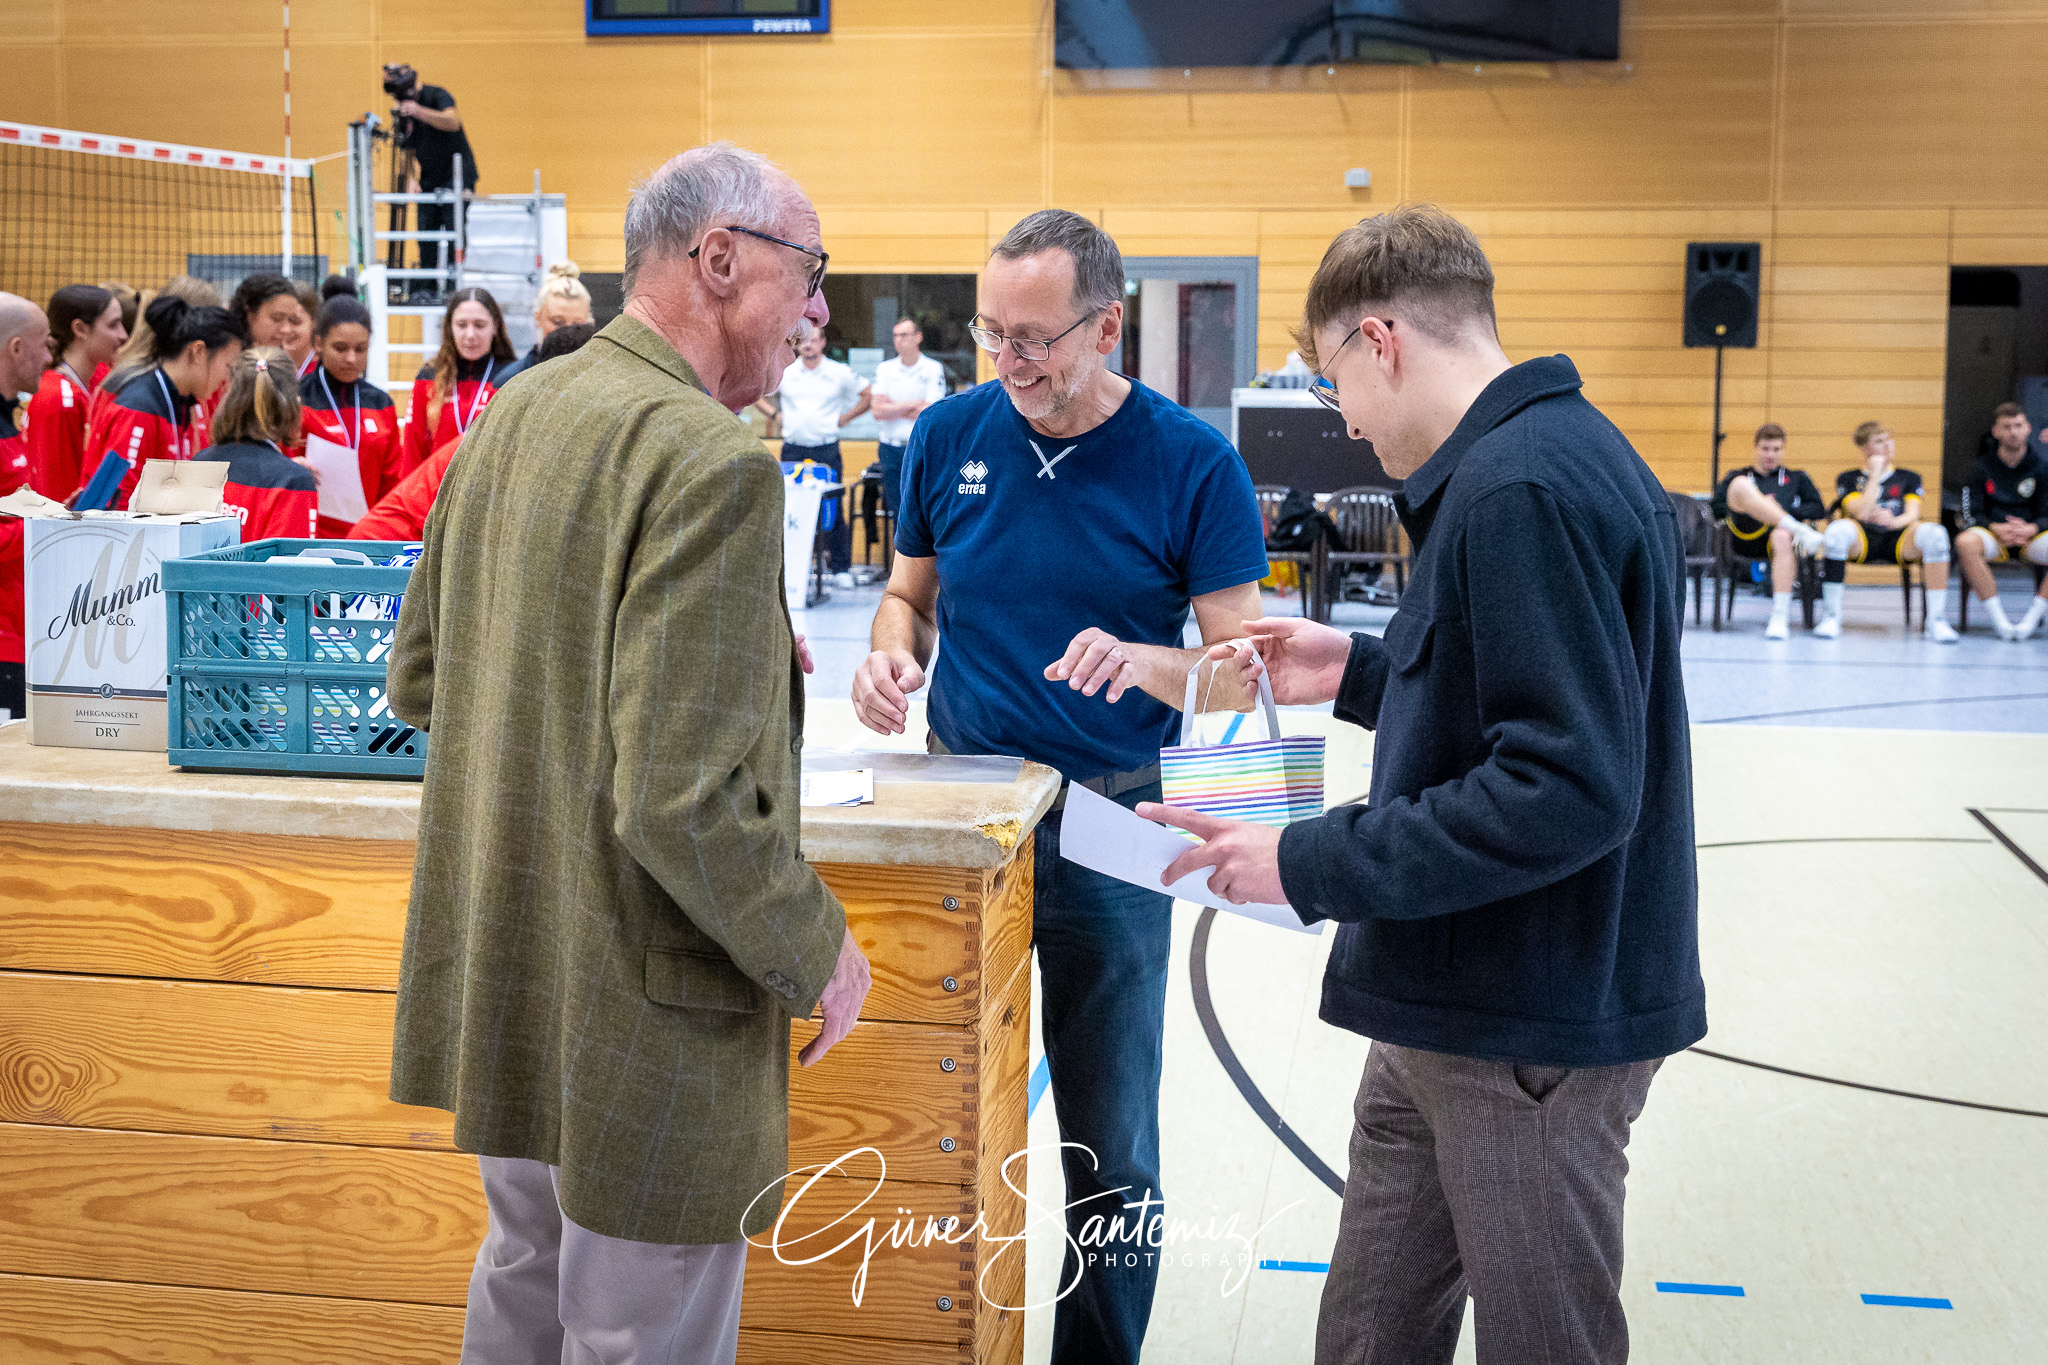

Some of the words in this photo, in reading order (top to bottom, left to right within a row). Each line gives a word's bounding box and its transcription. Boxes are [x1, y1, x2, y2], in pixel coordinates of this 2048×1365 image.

[48, 572, 162, 640] Mumm
[107, 613, 136, 627] &Co.
[76, 709, 139, 718] JAHRGANGSSEKT
[96, 727, 120, 737] DRY
